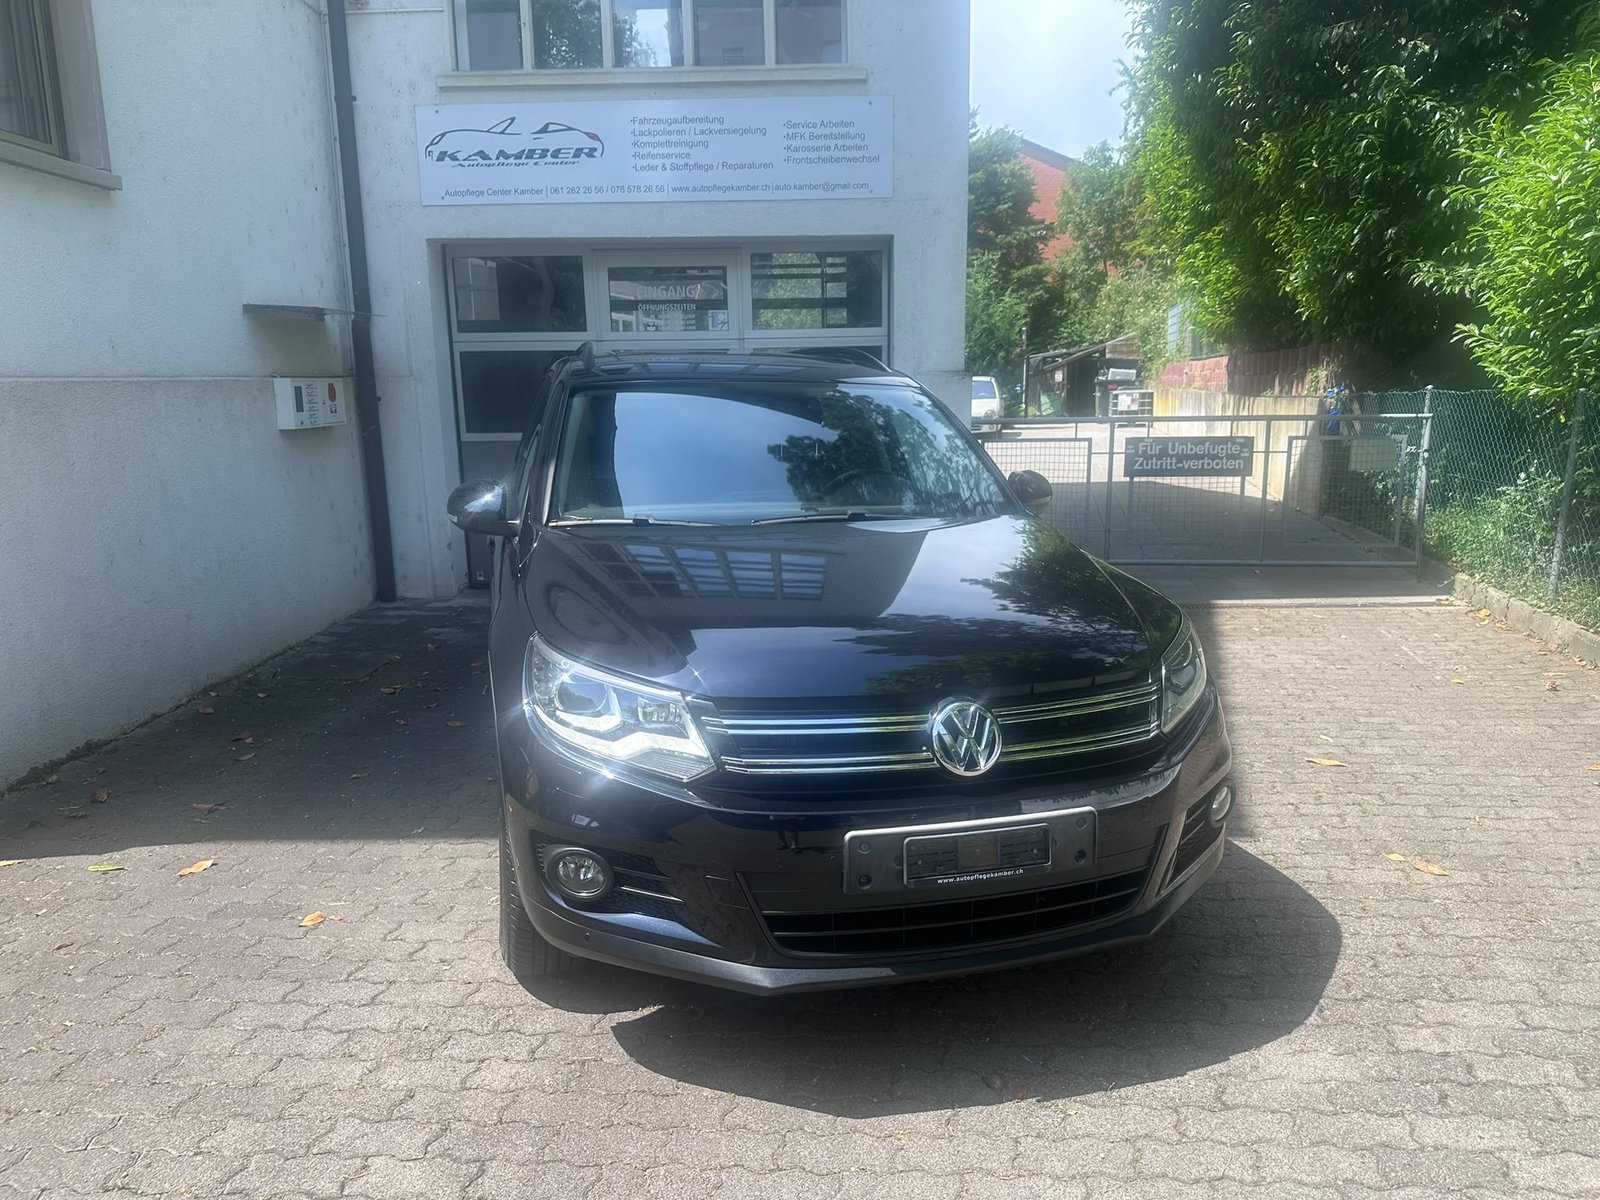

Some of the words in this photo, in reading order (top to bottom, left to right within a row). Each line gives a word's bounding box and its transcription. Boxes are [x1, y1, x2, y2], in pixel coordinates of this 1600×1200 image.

[820, 120, 855, 128] Arbeiten
[809, 131, 866, 141] Bereitstellung
[833, 143, 869, 152] Arbeiten
[435, 147, 598, 162] KAMBER
[661, 163, 667, 171] &
[669, 162, 714, 172] Stoffpflege
[721, 161, 774, 171] Reparaturen
[445, 189, 485, 198] Autopflege
[486, 187, 512, 196] Center
[513, 187, 544, 195] Kamber
[549, 186, 564, 194] 061
[566, 186, 581, 194] 262
[582, 186, 592, 194] 26
[610, 185, 626, 193] 076
[626, 185, 641, 193] 578
[636, 285, 696, 299] EINGANG
[637, 303, 696, 311] ÖFFNUNGSZEITEN
[1138, 442, 1162, 455] Für
[1168, 442, 1241, 457] Unbefugte
[1134, 457, 1244, 470] Zutritt-verboten
[937, 868, 1025, 884] www.autopflegekamber.ch
